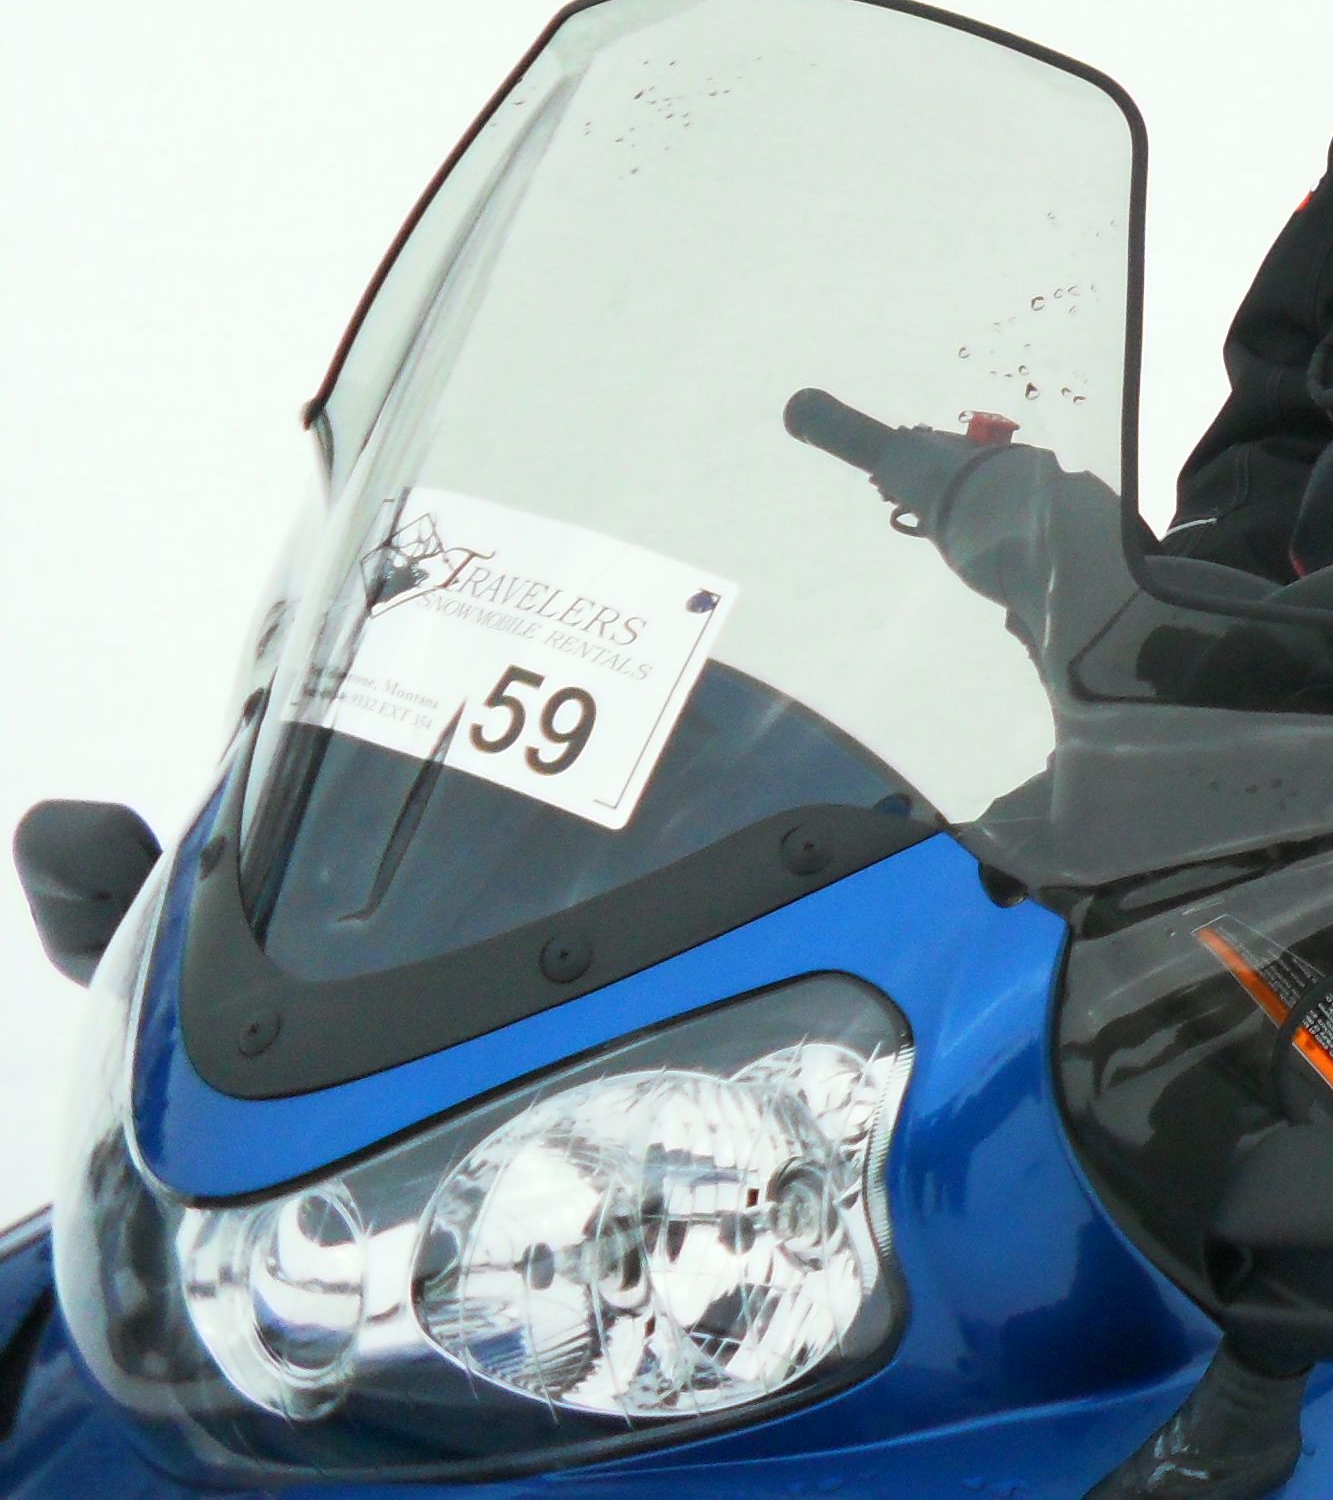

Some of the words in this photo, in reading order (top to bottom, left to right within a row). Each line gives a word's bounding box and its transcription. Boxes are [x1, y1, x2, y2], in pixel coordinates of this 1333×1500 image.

[415, 591, 541, 642] SNOWMOBILE
[542, 627, 654, 683] RENTALS
[437, 545, 648, 648] TRAVELERS
[382, 678, 440, 710] Montana
[468, 663, 599, 777] 59
